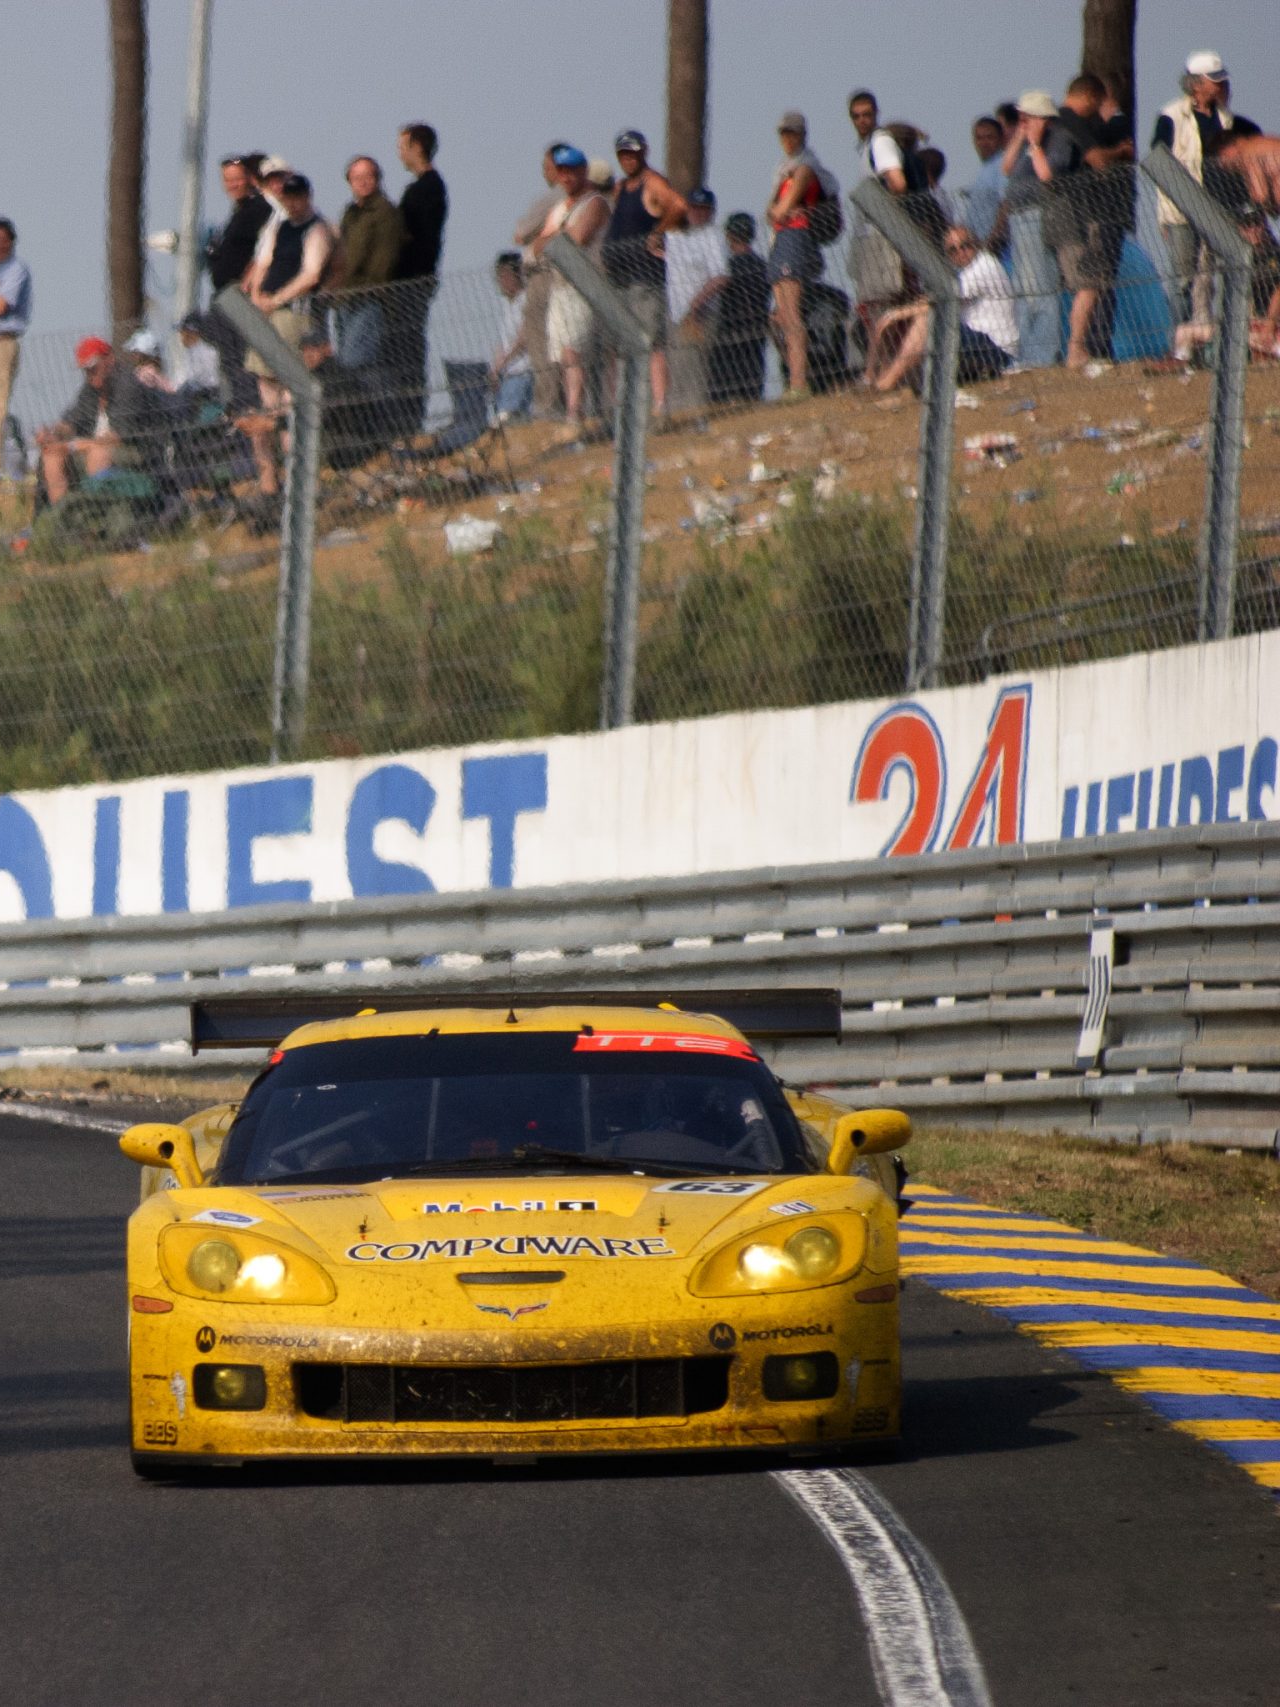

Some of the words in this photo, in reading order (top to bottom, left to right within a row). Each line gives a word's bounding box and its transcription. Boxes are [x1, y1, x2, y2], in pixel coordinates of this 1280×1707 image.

[850, 682, 1033, 859] 24
[671, 1181, 750, 1195] 63
[348, 1236, 673, 1261] COMPUWARE
[220, 1334, 320, 1348] MOTOROLA
[742, 1324, 835, 1342] MOTOROLA
